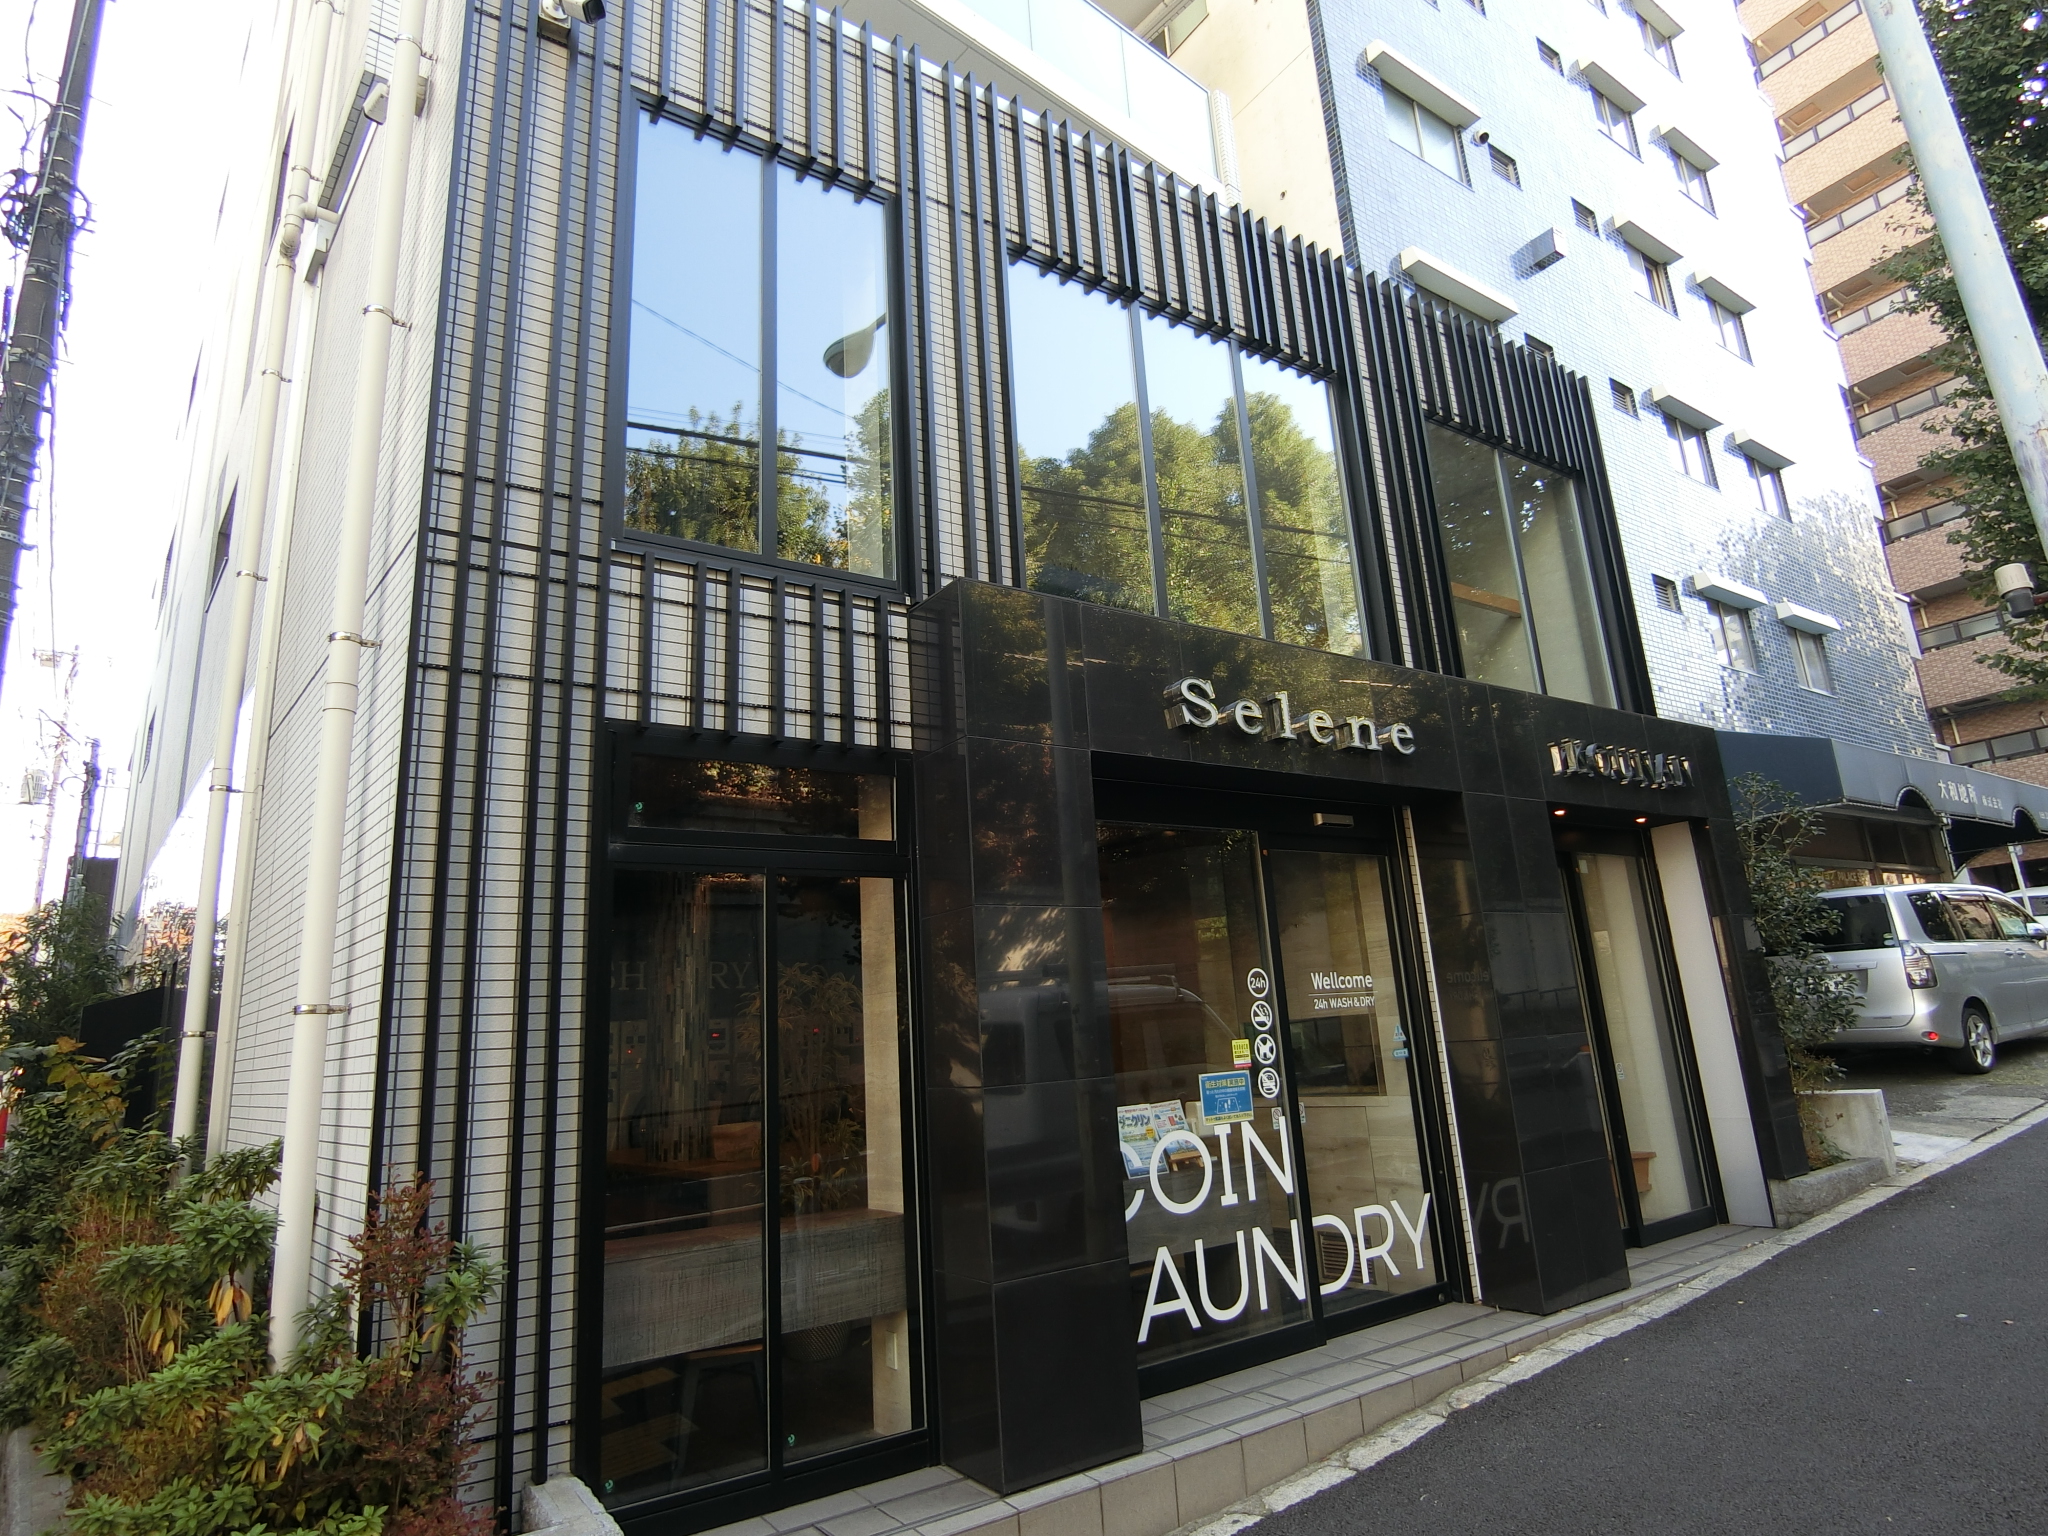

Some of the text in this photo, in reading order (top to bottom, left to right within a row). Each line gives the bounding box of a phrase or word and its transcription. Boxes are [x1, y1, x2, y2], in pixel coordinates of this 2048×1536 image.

[1170, 677, 1416, 755] Selene
[1937, 779, 1978, 804] 大和地所
[1250, 977, 1266, 989] 24h
[1311, 971, 1373, 990] Wellcome
[1314, 998, 1328, 1010] 24h
